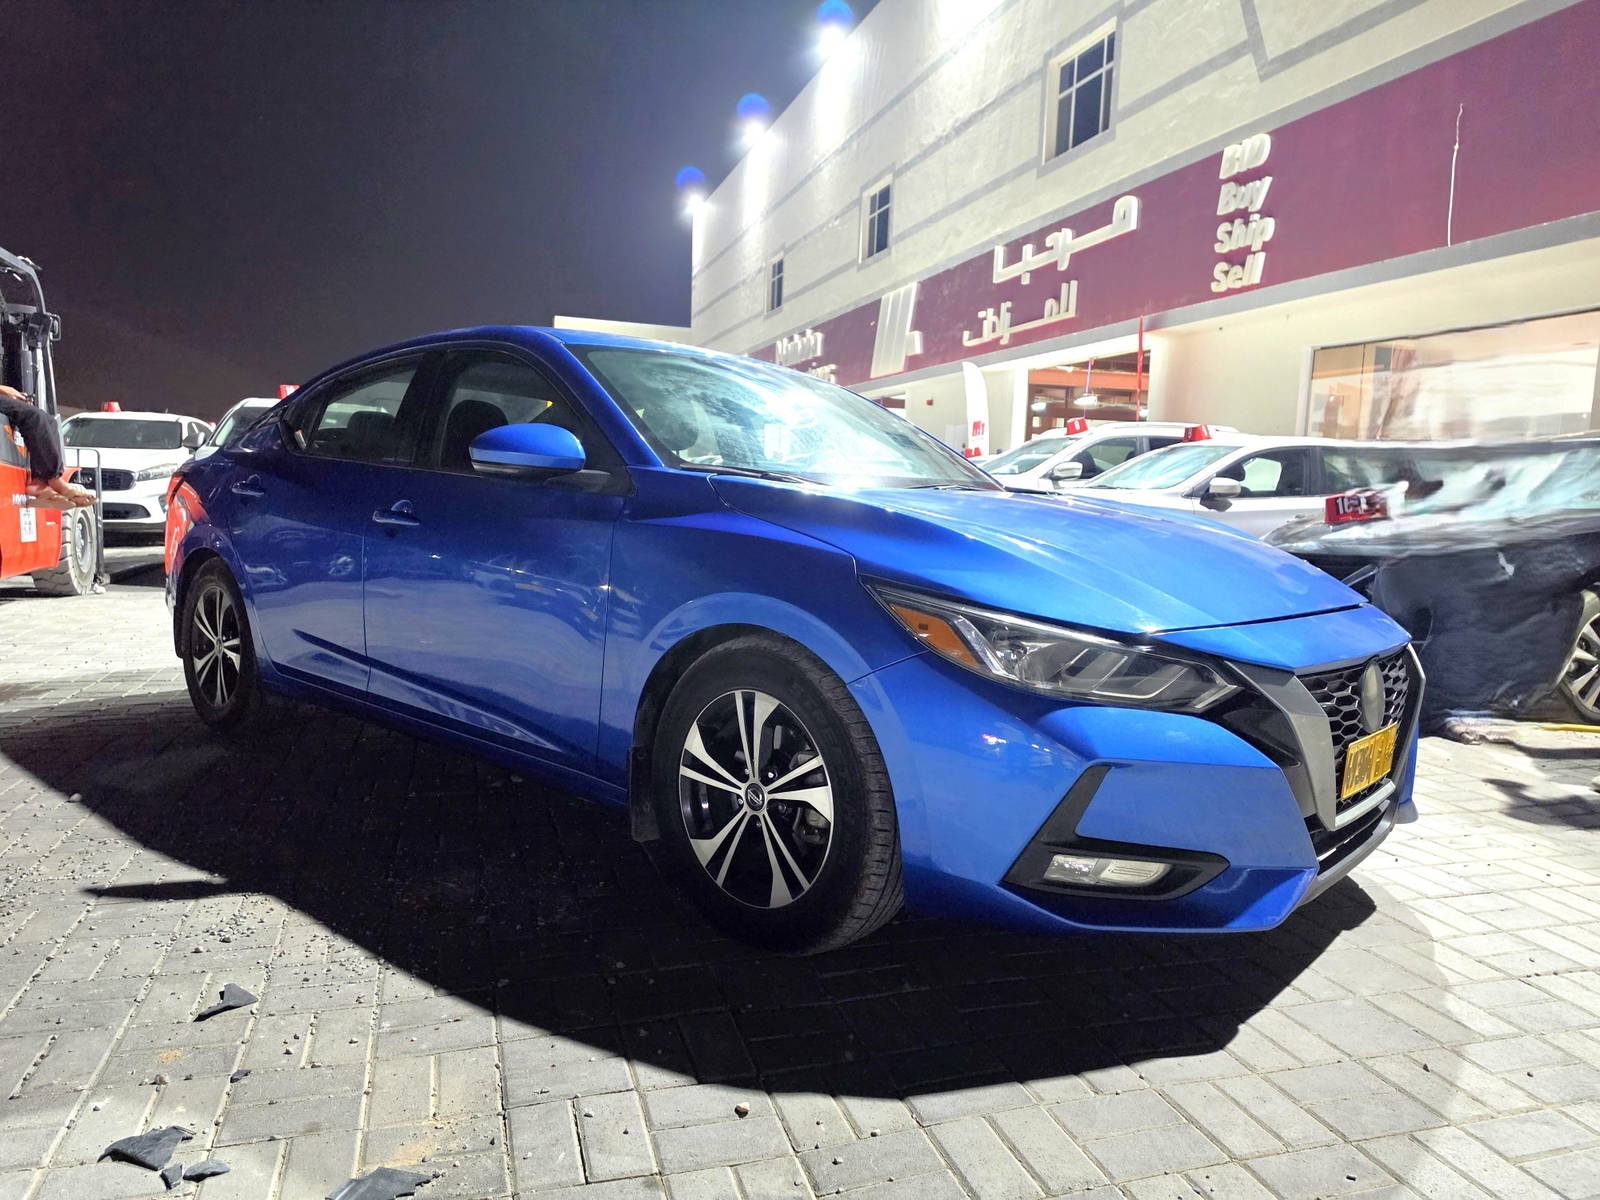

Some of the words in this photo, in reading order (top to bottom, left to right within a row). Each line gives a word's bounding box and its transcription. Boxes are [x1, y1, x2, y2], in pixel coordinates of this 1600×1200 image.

[1216, 176, 1273, 215] Buy
[1214, 213, 1275, 253] Ship
[1211, 252, 1266, 292] Sell
